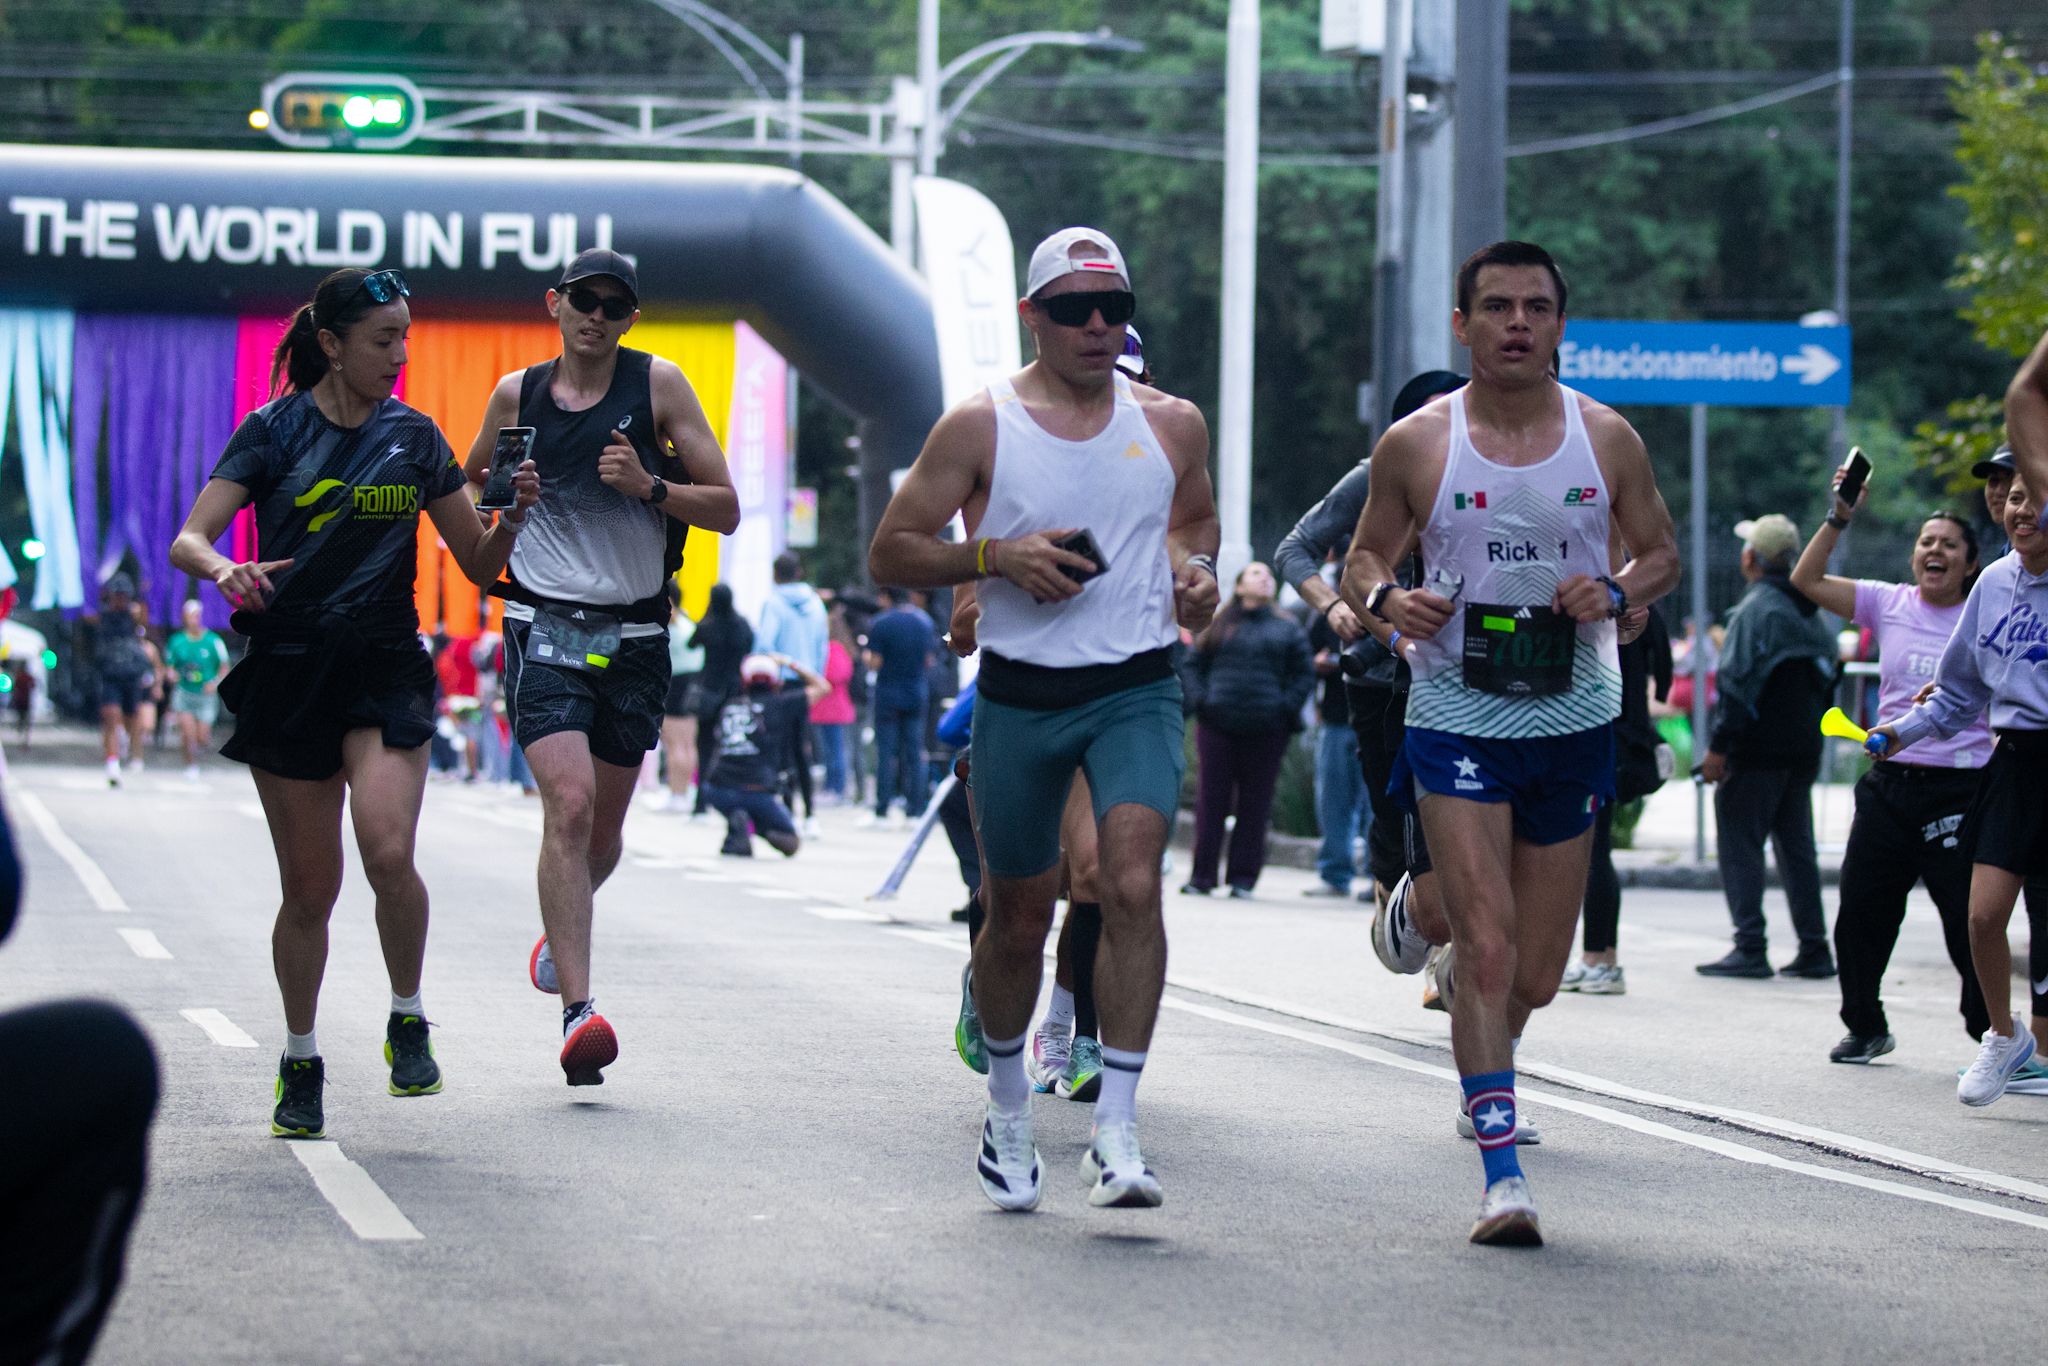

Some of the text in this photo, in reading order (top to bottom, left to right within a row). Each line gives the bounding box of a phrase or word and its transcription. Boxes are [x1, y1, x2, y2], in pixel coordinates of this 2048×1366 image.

[9, 196, 139, 259] THE
[152, 203, 387, 268] WORLD
[402, 210, 464, 270] IN
[1559, 340, 1778, 381] Estacionamiento
[1563, 487, 1598, 503] BP
[1487, 540, 1568, 562] Rick 1
[1489, 630, 1570, 668] 7021
